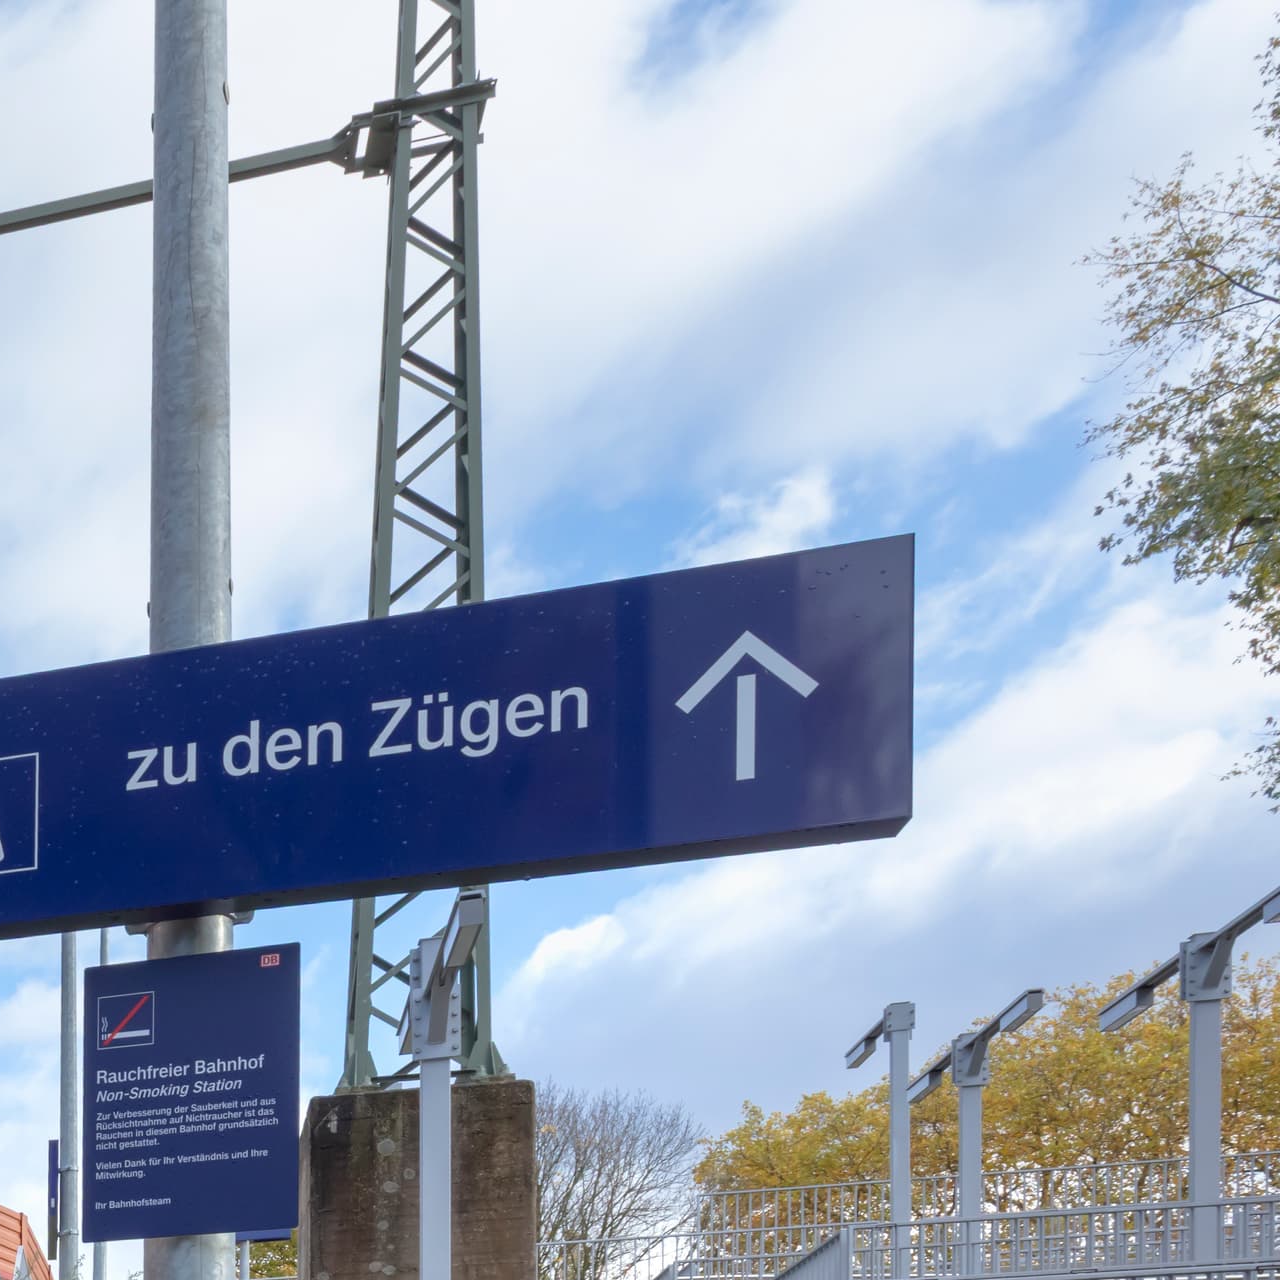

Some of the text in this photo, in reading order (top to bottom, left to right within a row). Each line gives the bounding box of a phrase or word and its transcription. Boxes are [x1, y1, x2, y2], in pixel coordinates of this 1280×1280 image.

[125, 686, 590, 791] zu den Zügen
[263, 955, 278, 966] DB
[96, 1054, 265, 1084] Rauchfreier Bahnhof
[96, 1078, 242, 1103] Non-Smoking Station
[95, 1107, 275, 1131] Rücksichtnahme auf Nichtraucher ist das
[96, 1097, 276, 1121] Zur Verbesserung der Sauberkeit und aus
[95, 1116, 279, 1141] Rauchen in diesem Bahnhof grundsätzlich
[95, 1137, 160, 1151] nicht gestattet.
[95, 1148, 268, 1170] Vielen Dank für Ihr Verständnis und Ihre
[95, 1169, 146, 1180] Mitwirkung.
[94, 1197, 171, 1210] Ihr Bahnhofsteam
